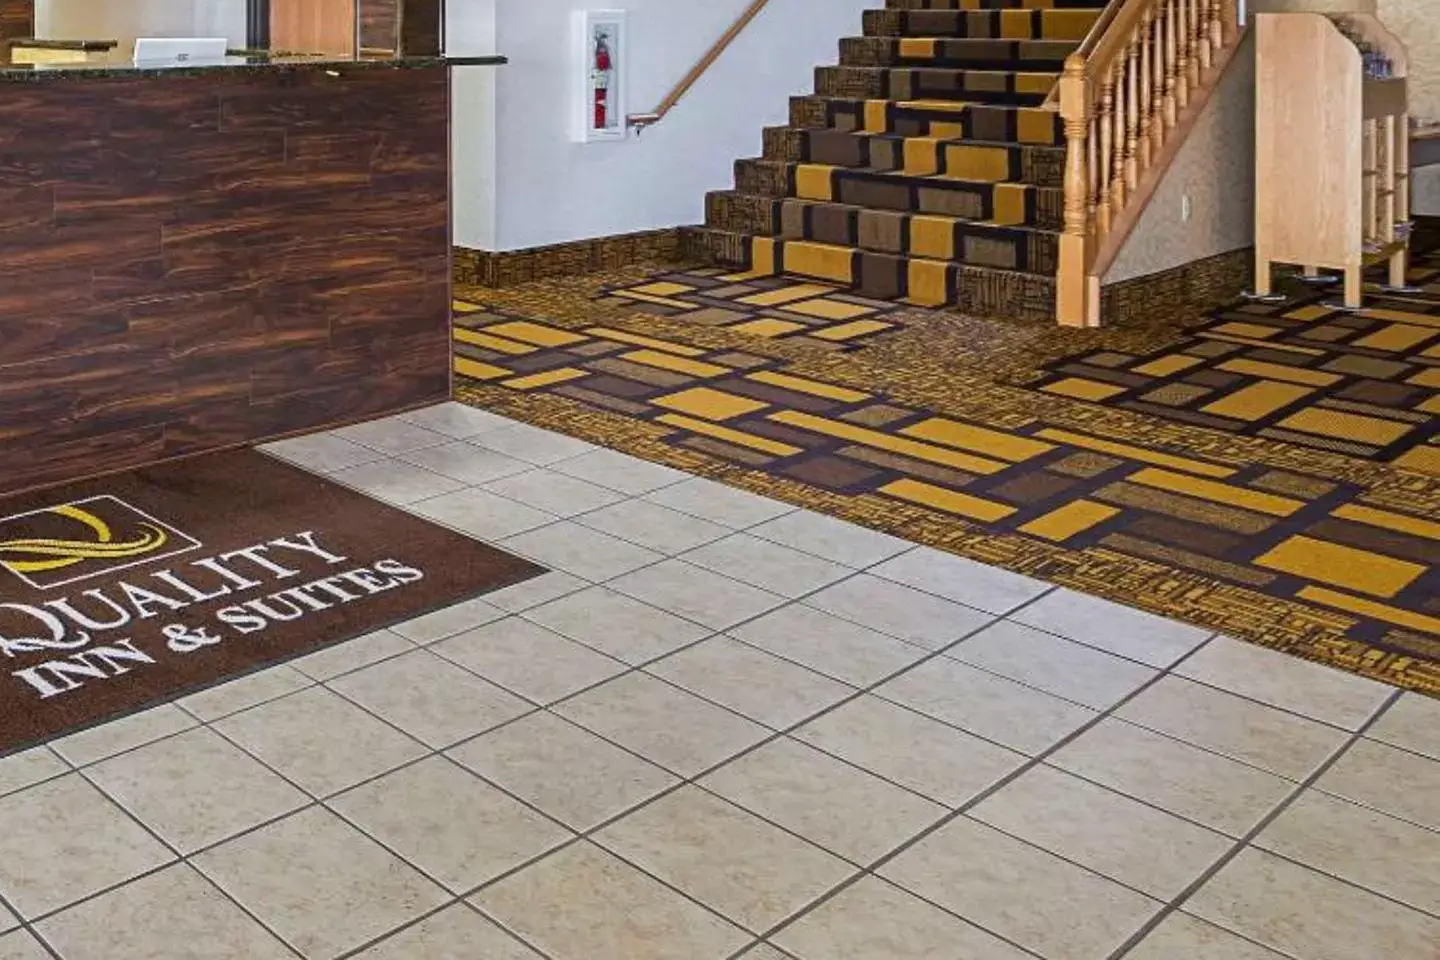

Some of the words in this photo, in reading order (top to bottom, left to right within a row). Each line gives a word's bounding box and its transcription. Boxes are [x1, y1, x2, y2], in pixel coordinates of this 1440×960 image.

[11, 638, 157, 700] INN
[162, 622, 222, 653] &
[216, 557, 425, 635] SUITES
